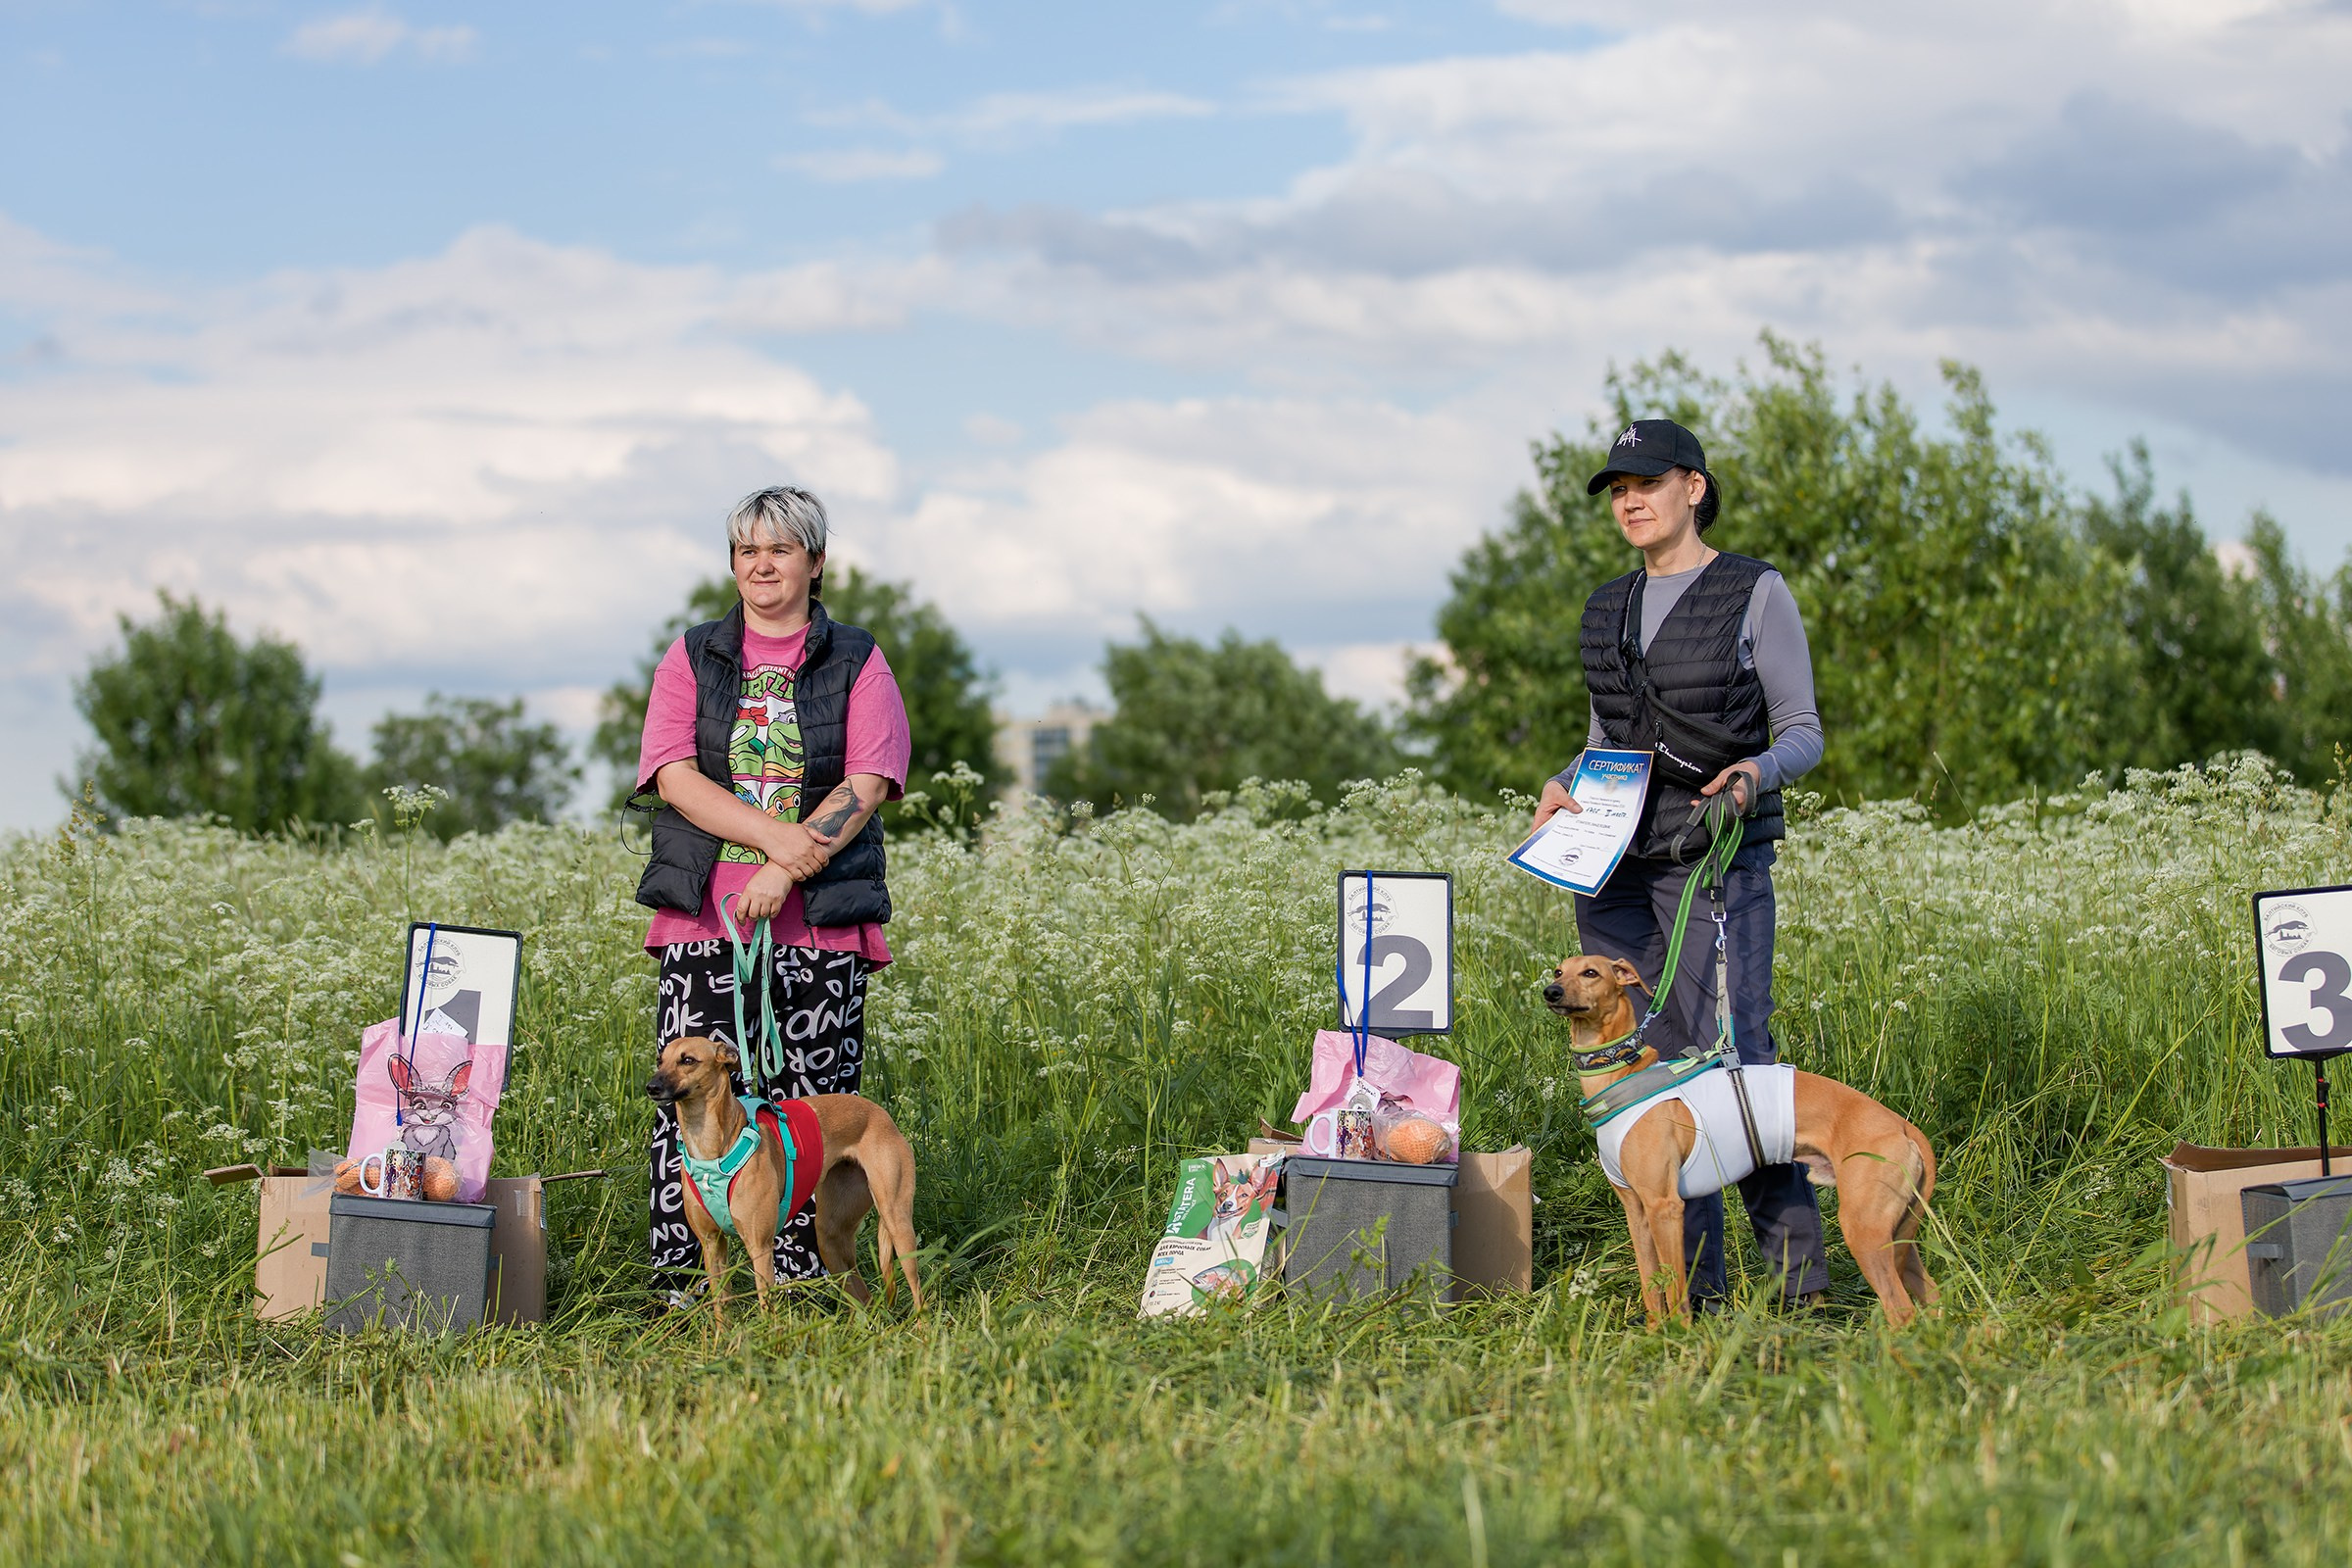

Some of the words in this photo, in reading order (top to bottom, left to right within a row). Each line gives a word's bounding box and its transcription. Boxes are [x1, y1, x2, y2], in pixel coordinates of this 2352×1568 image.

[760, 664, 788, 674] MUTANT
[1589, 760, 1644, 774] СЕРТИФИКАТ
[1655, 741, 1703, 774] Champion
[1356, 935, 1434, 1029] 2
[2278, 951, 2352, 1052] 3
[1173, 1177, 1197, 1223] STATERA
